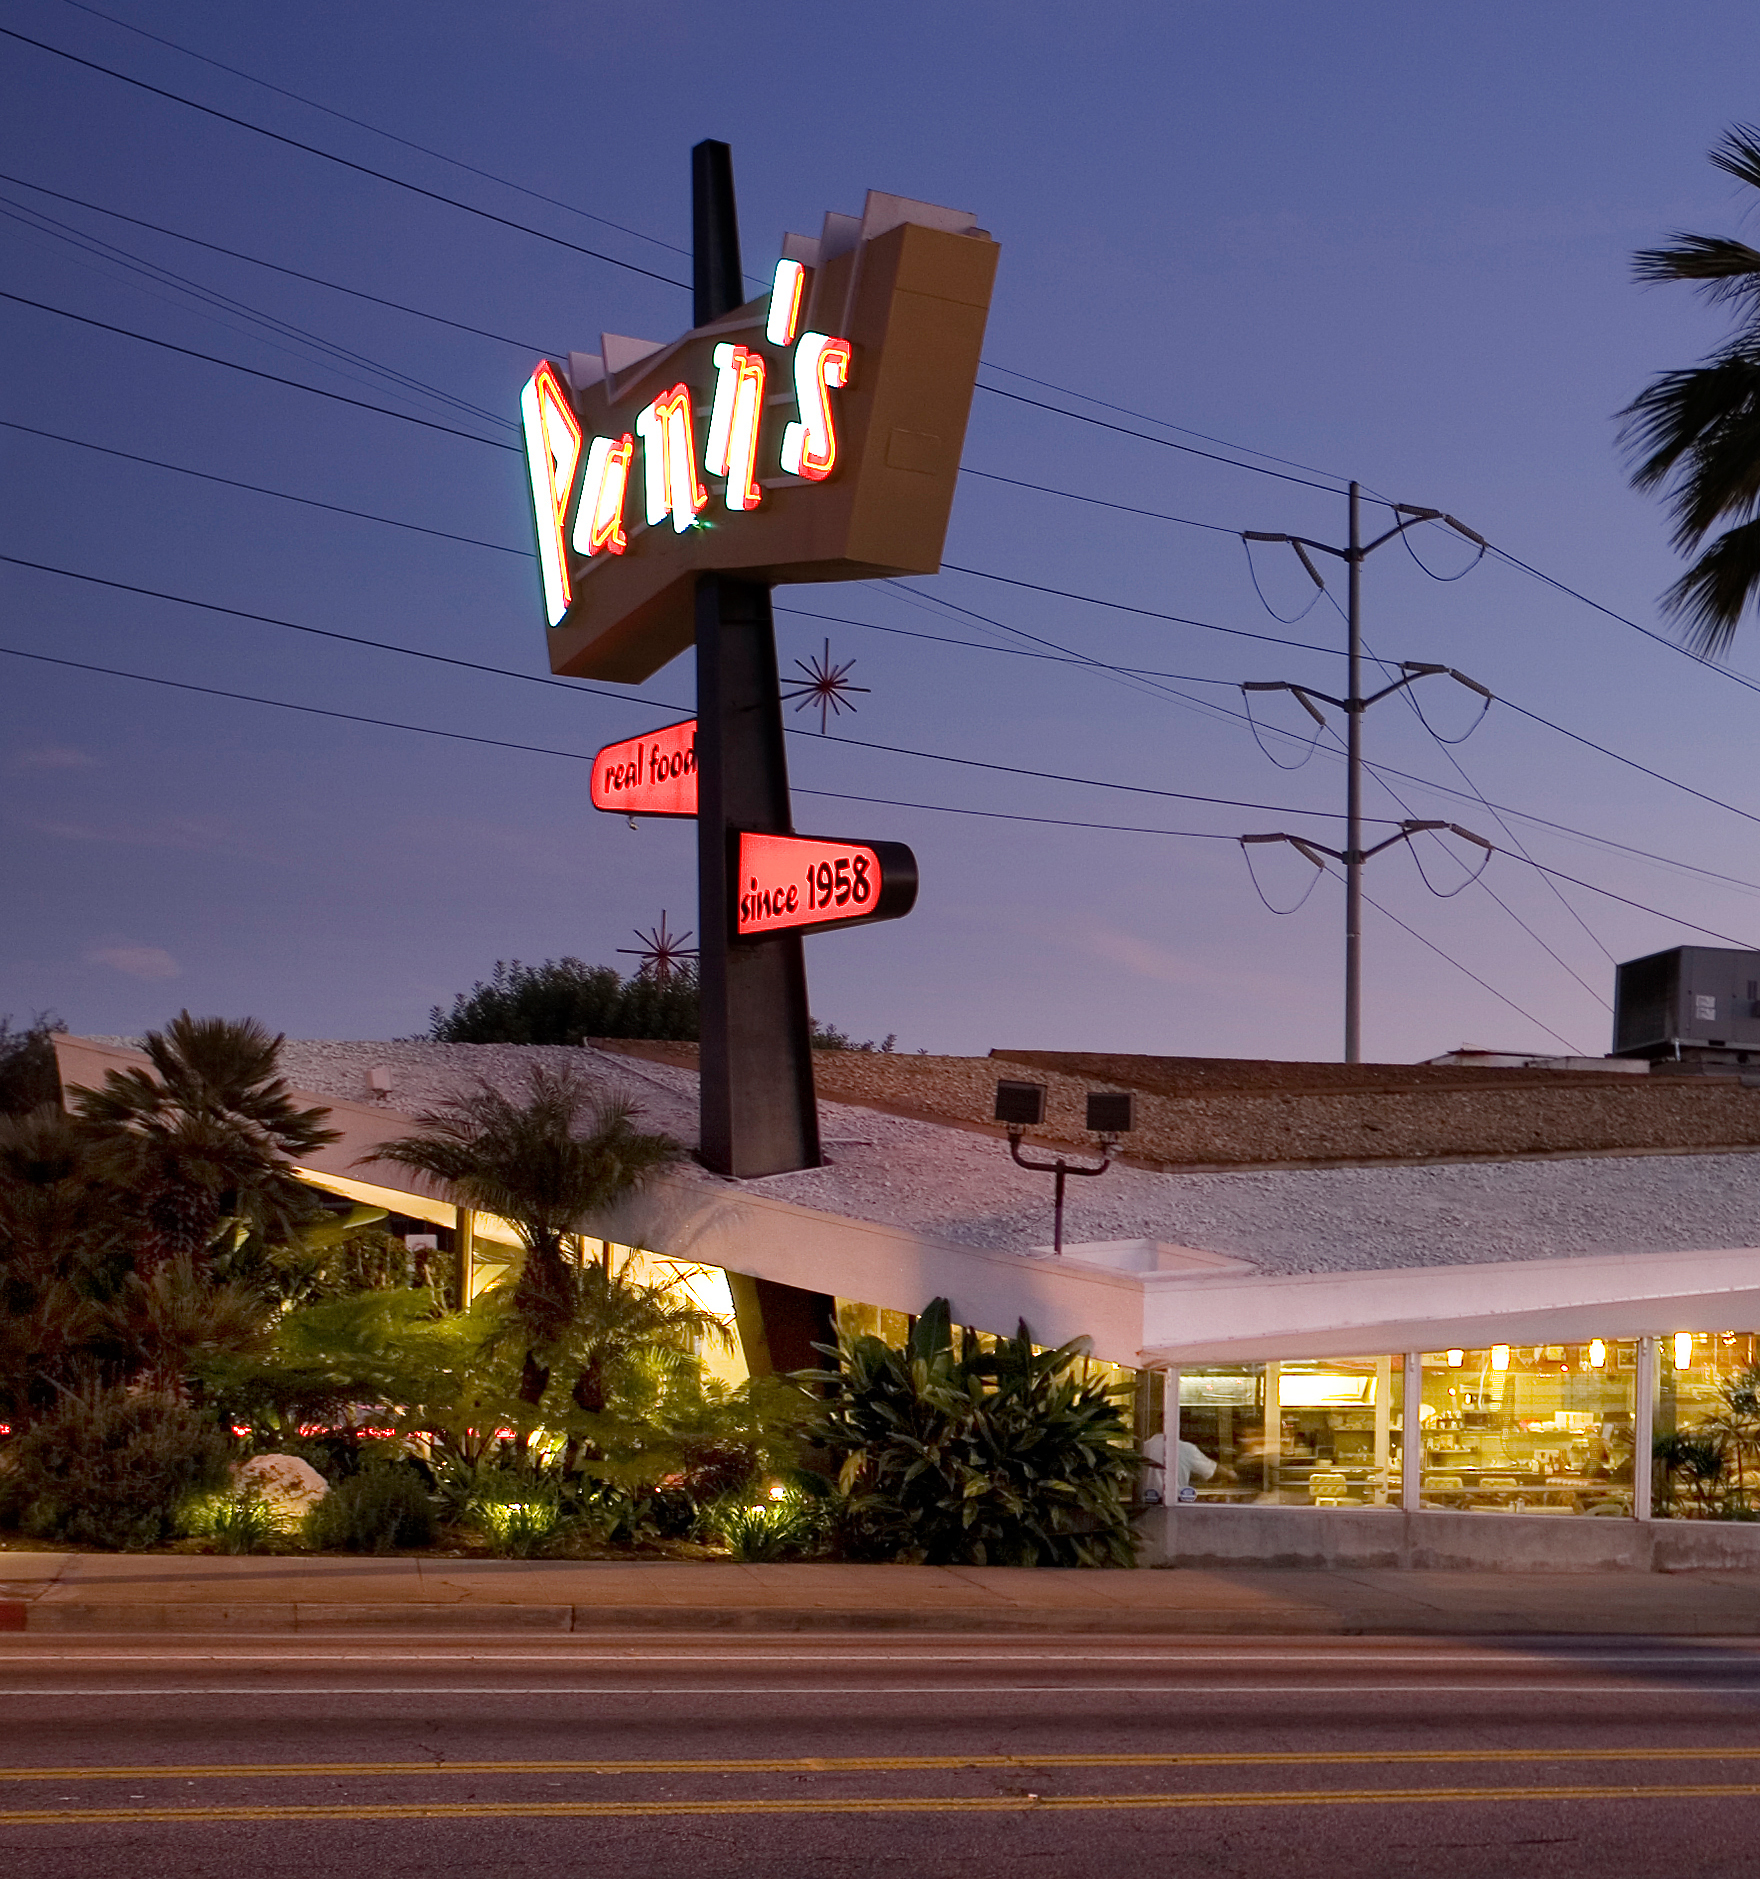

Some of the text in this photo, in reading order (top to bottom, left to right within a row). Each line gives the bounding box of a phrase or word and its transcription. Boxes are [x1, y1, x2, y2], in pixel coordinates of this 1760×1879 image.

[520, 258, 852, 628] Pann's
[604, 743, 644, 794] real
[740, 855, 871, 923] since 1958
